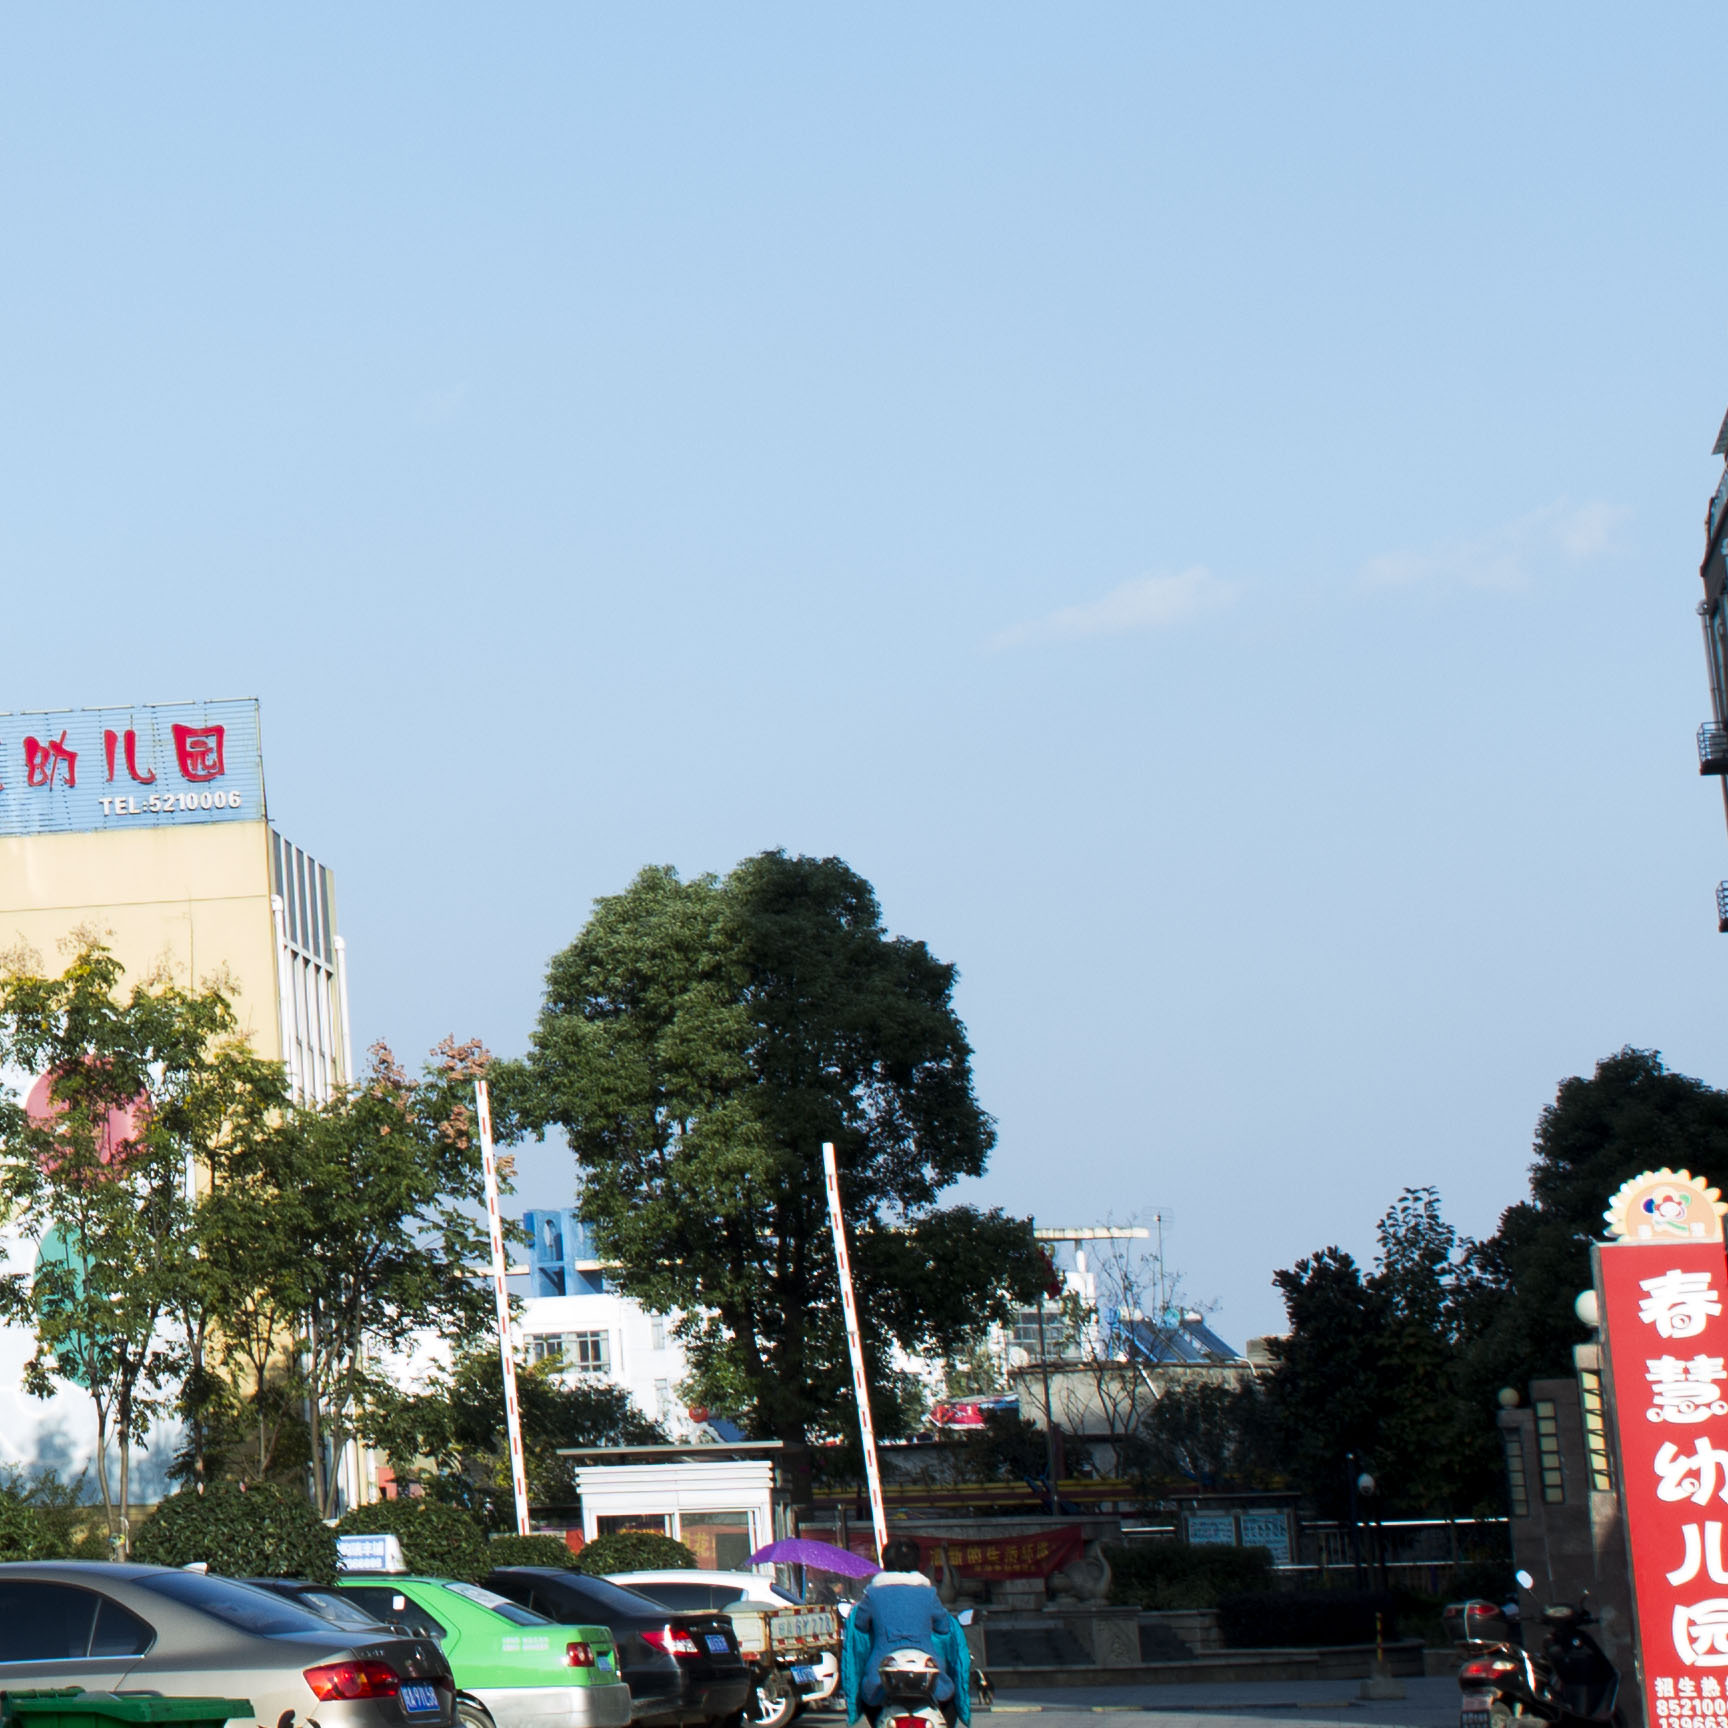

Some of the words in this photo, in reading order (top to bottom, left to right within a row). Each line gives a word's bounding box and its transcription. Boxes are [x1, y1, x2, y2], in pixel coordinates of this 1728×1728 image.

[98, 790, 242, 817] TEL:5210006
[1638, 1268, 1728, 1670] 春慧幼儿园
[1655, 1675, 1728, 1698] 招生热
[1655, 1698, 1728, 1717] 852100
